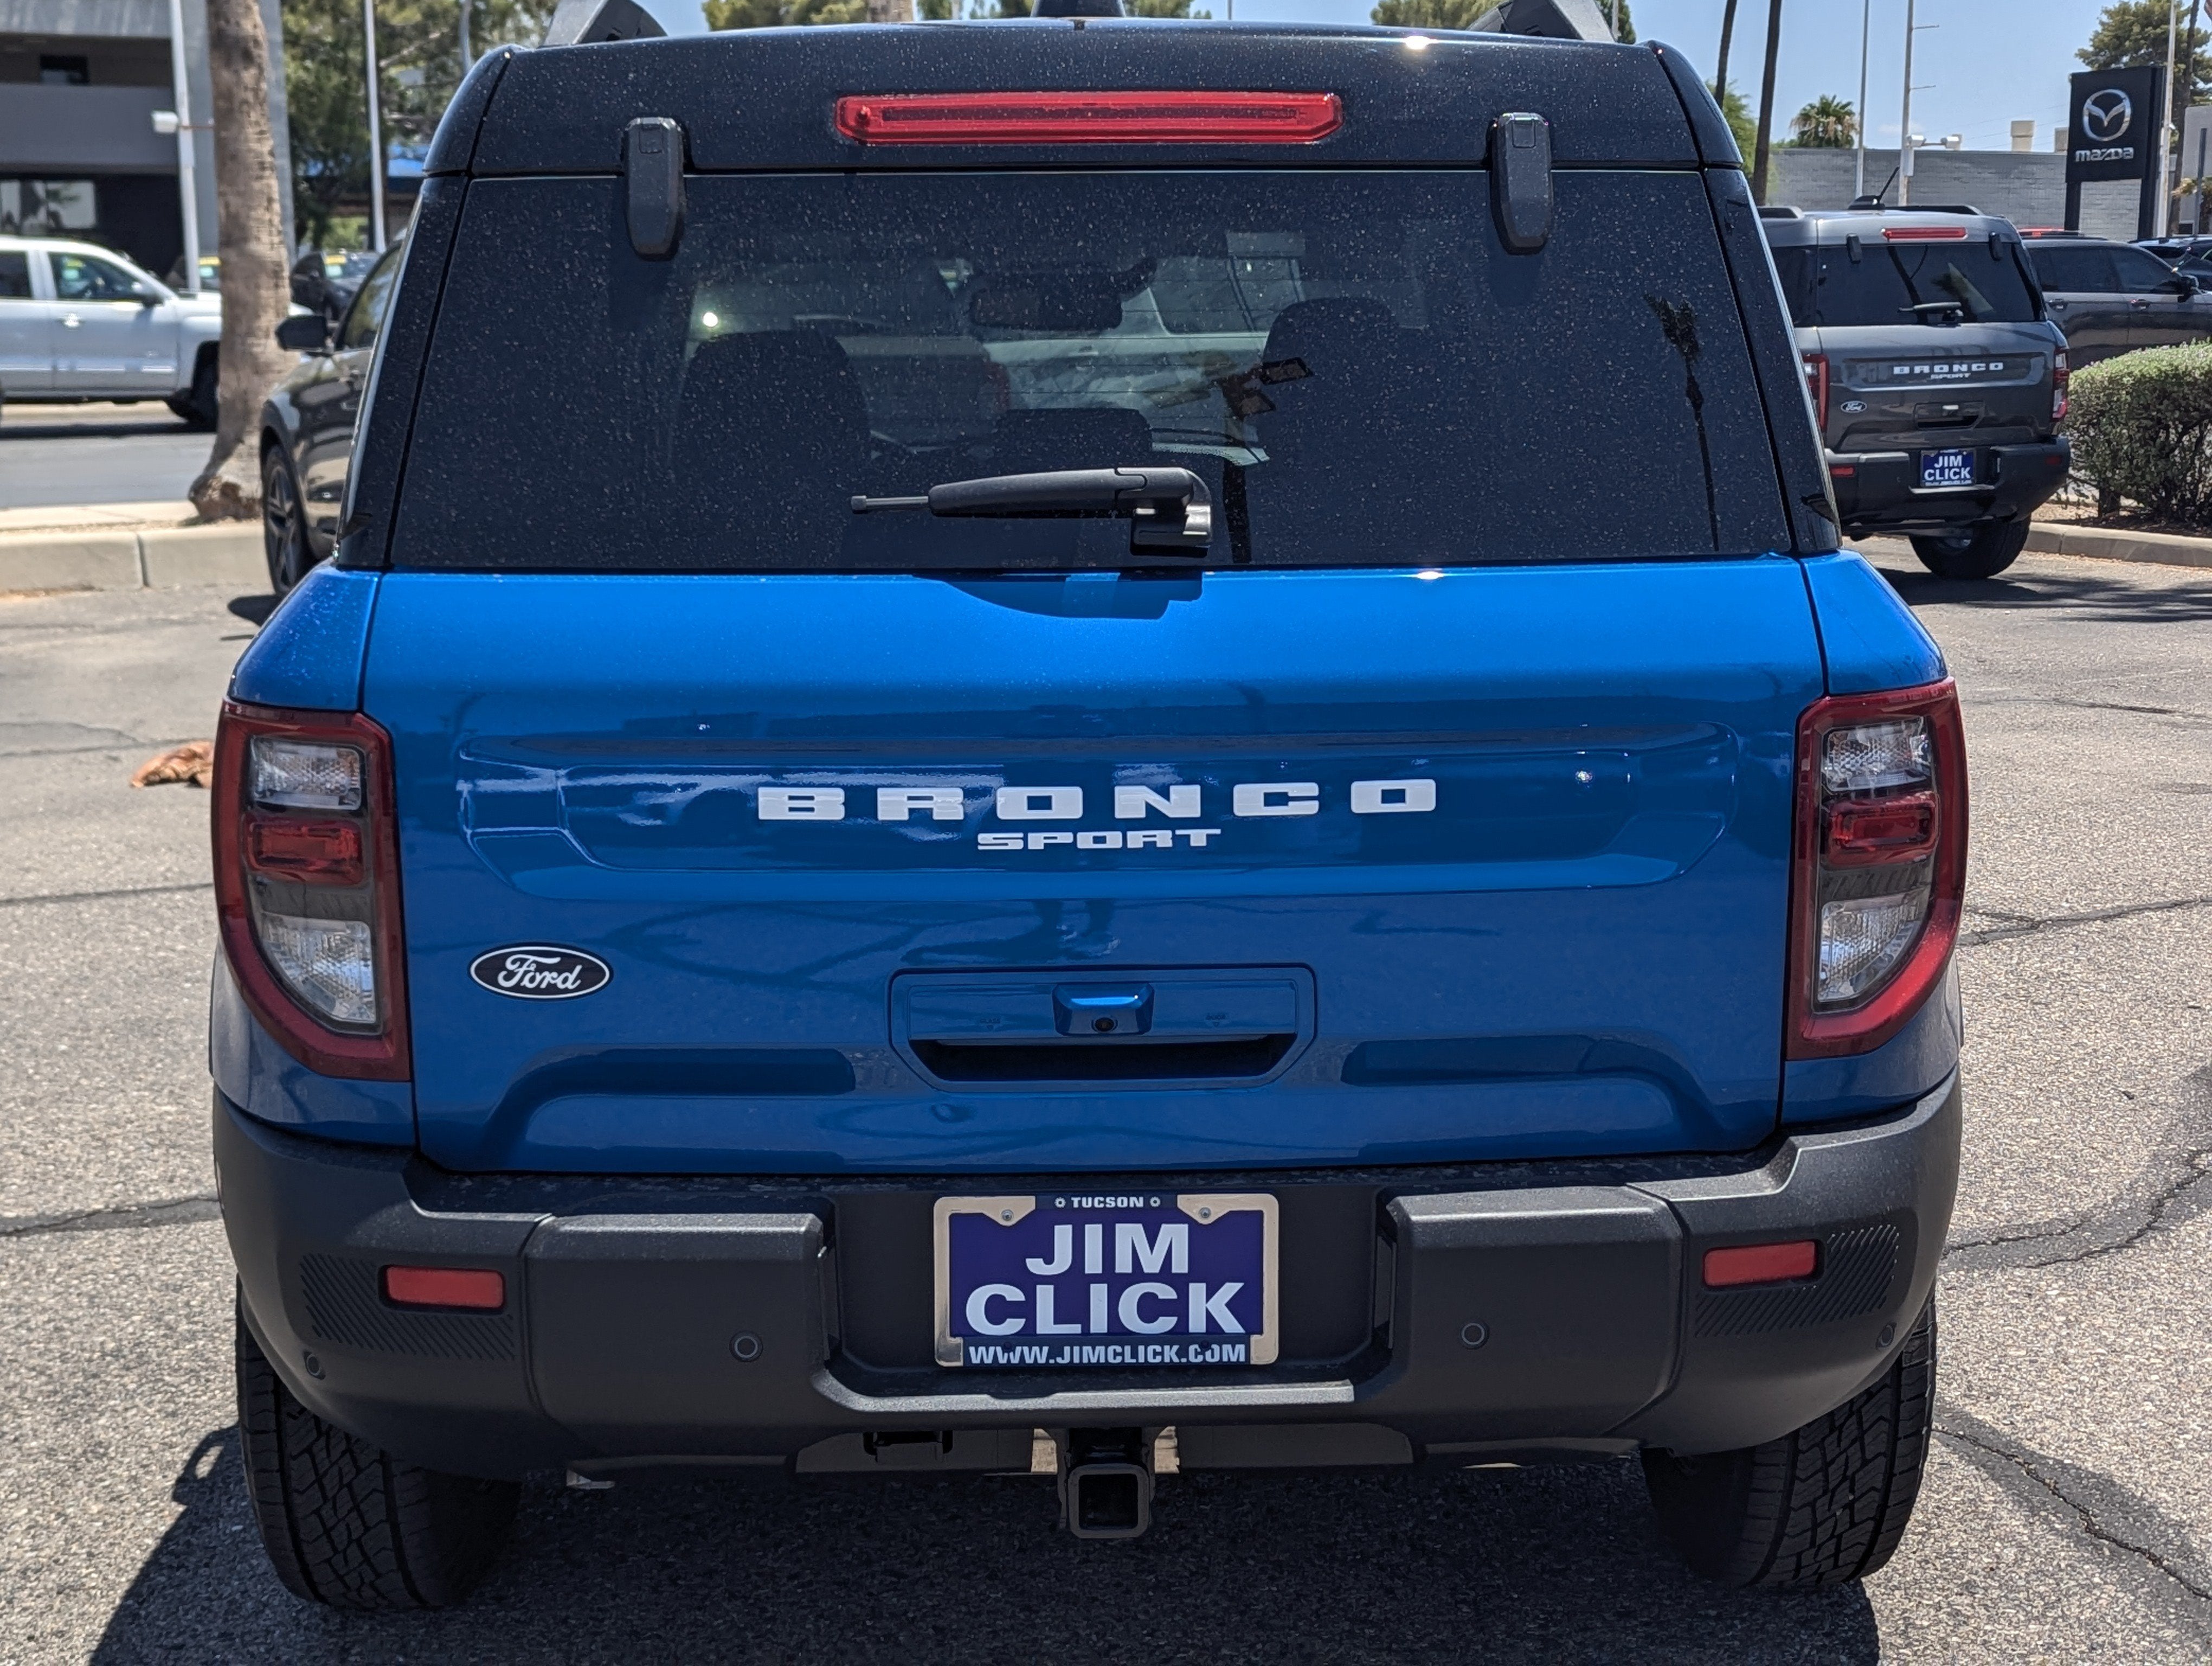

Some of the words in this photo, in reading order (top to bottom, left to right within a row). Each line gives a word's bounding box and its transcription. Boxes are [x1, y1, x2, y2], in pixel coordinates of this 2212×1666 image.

[1893, 362, 2003, 374] BRONCO
[1934, 455, 1962, 467] JIM
[1924, 467, 1971, 480] CLICK
[757, 779, 1436, 820] BRONCO
[976, 829, 1221, 850] SPORT
[497, 953, 582, 990] Ford
[1071, 1196, 1144, 1208] TUCSON
[1025, 1223, 1188, 1276] JIM
[965, 1281, 1246, 1336] CLICK
[968, 1343, 1246, 1364] WWW.JIMCLICK.COM
